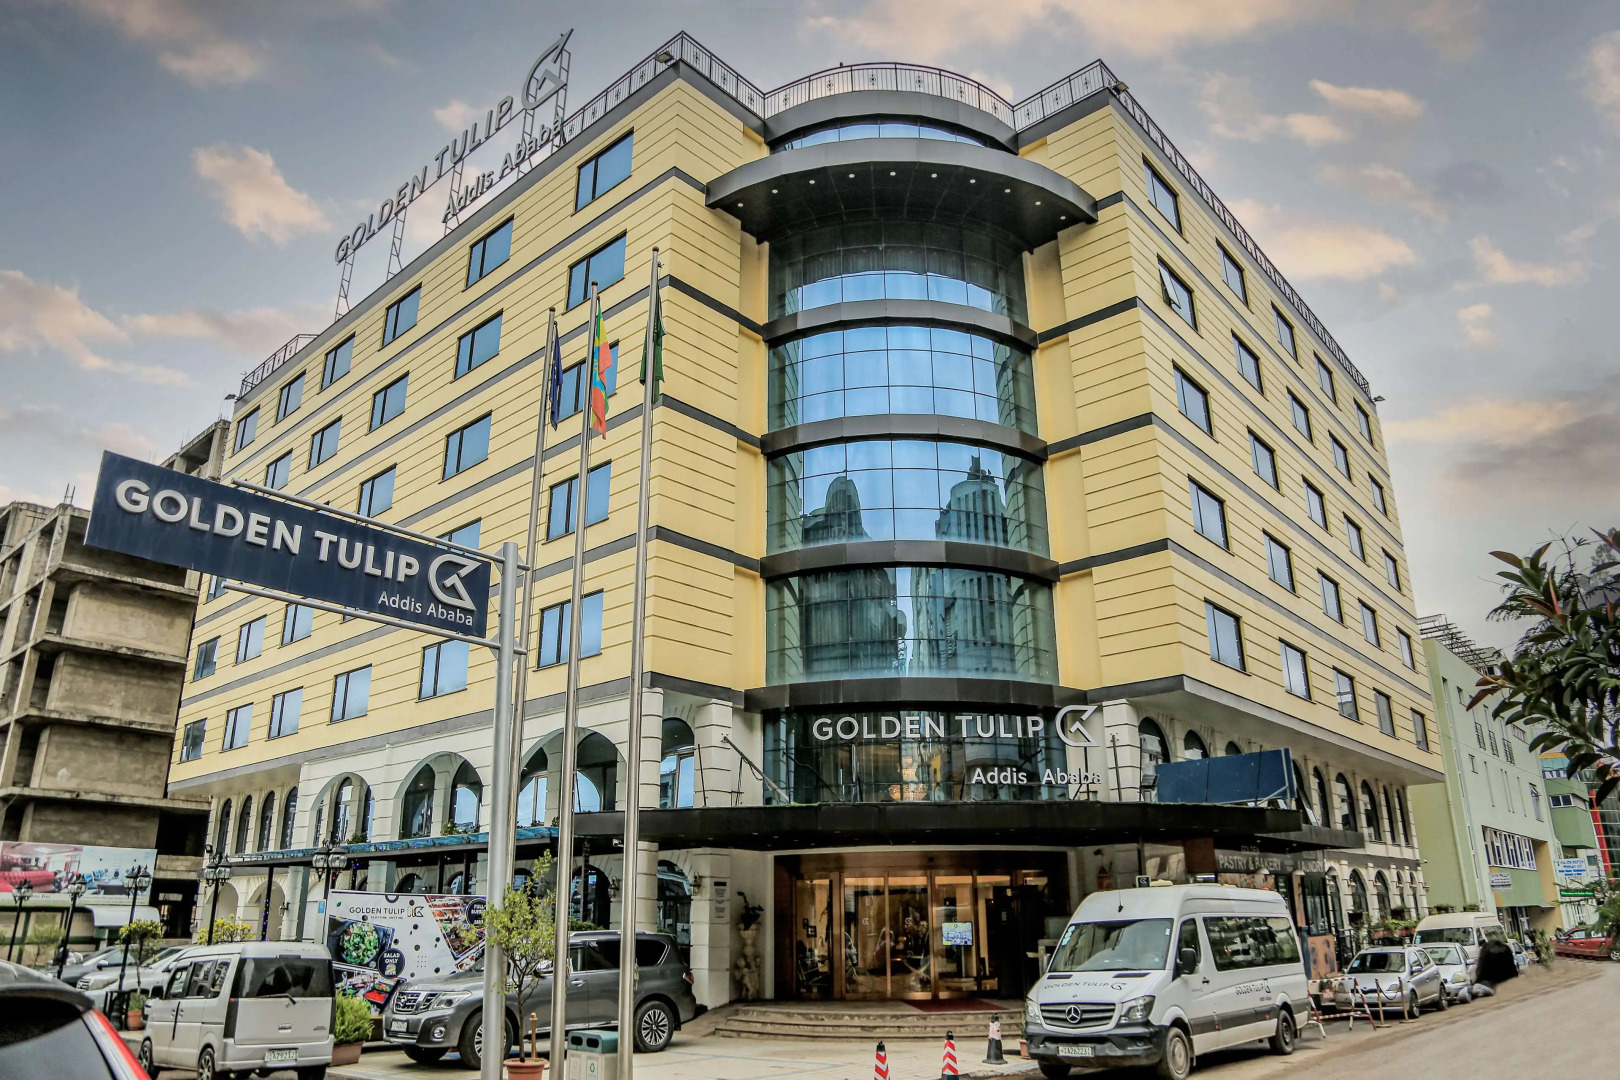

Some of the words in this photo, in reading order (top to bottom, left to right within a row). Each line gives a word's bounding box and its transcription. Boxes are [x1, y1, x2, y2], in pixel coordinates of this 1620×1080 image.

[334, 165, 428, 265] GOLDEN
[435, 96, 514, 178] TULIP
[442, 169, 495, 224] Addis
[499, 115, 564, 180] Ababa
[115, 479, 302, 555] GOLDEN
[314, 530, 420, 582] TULIP
[378, 590, 422, 614] Addis
[426, 602, 474, 626] Ababa
[812, 716, 945, 741] GOLDEN
[955, 715, 1044, 738] TULIP
[971, 767, 1028, 785] Addis
[1042, 767, 1102, 785] Ababa
[1219, 855, 1248, 870] PASTRY
[1248, 858, 1255, 871] &
[1255, 858, 1282, 872] BAKERY
[349, 906, 382, 914] GOLDEN
